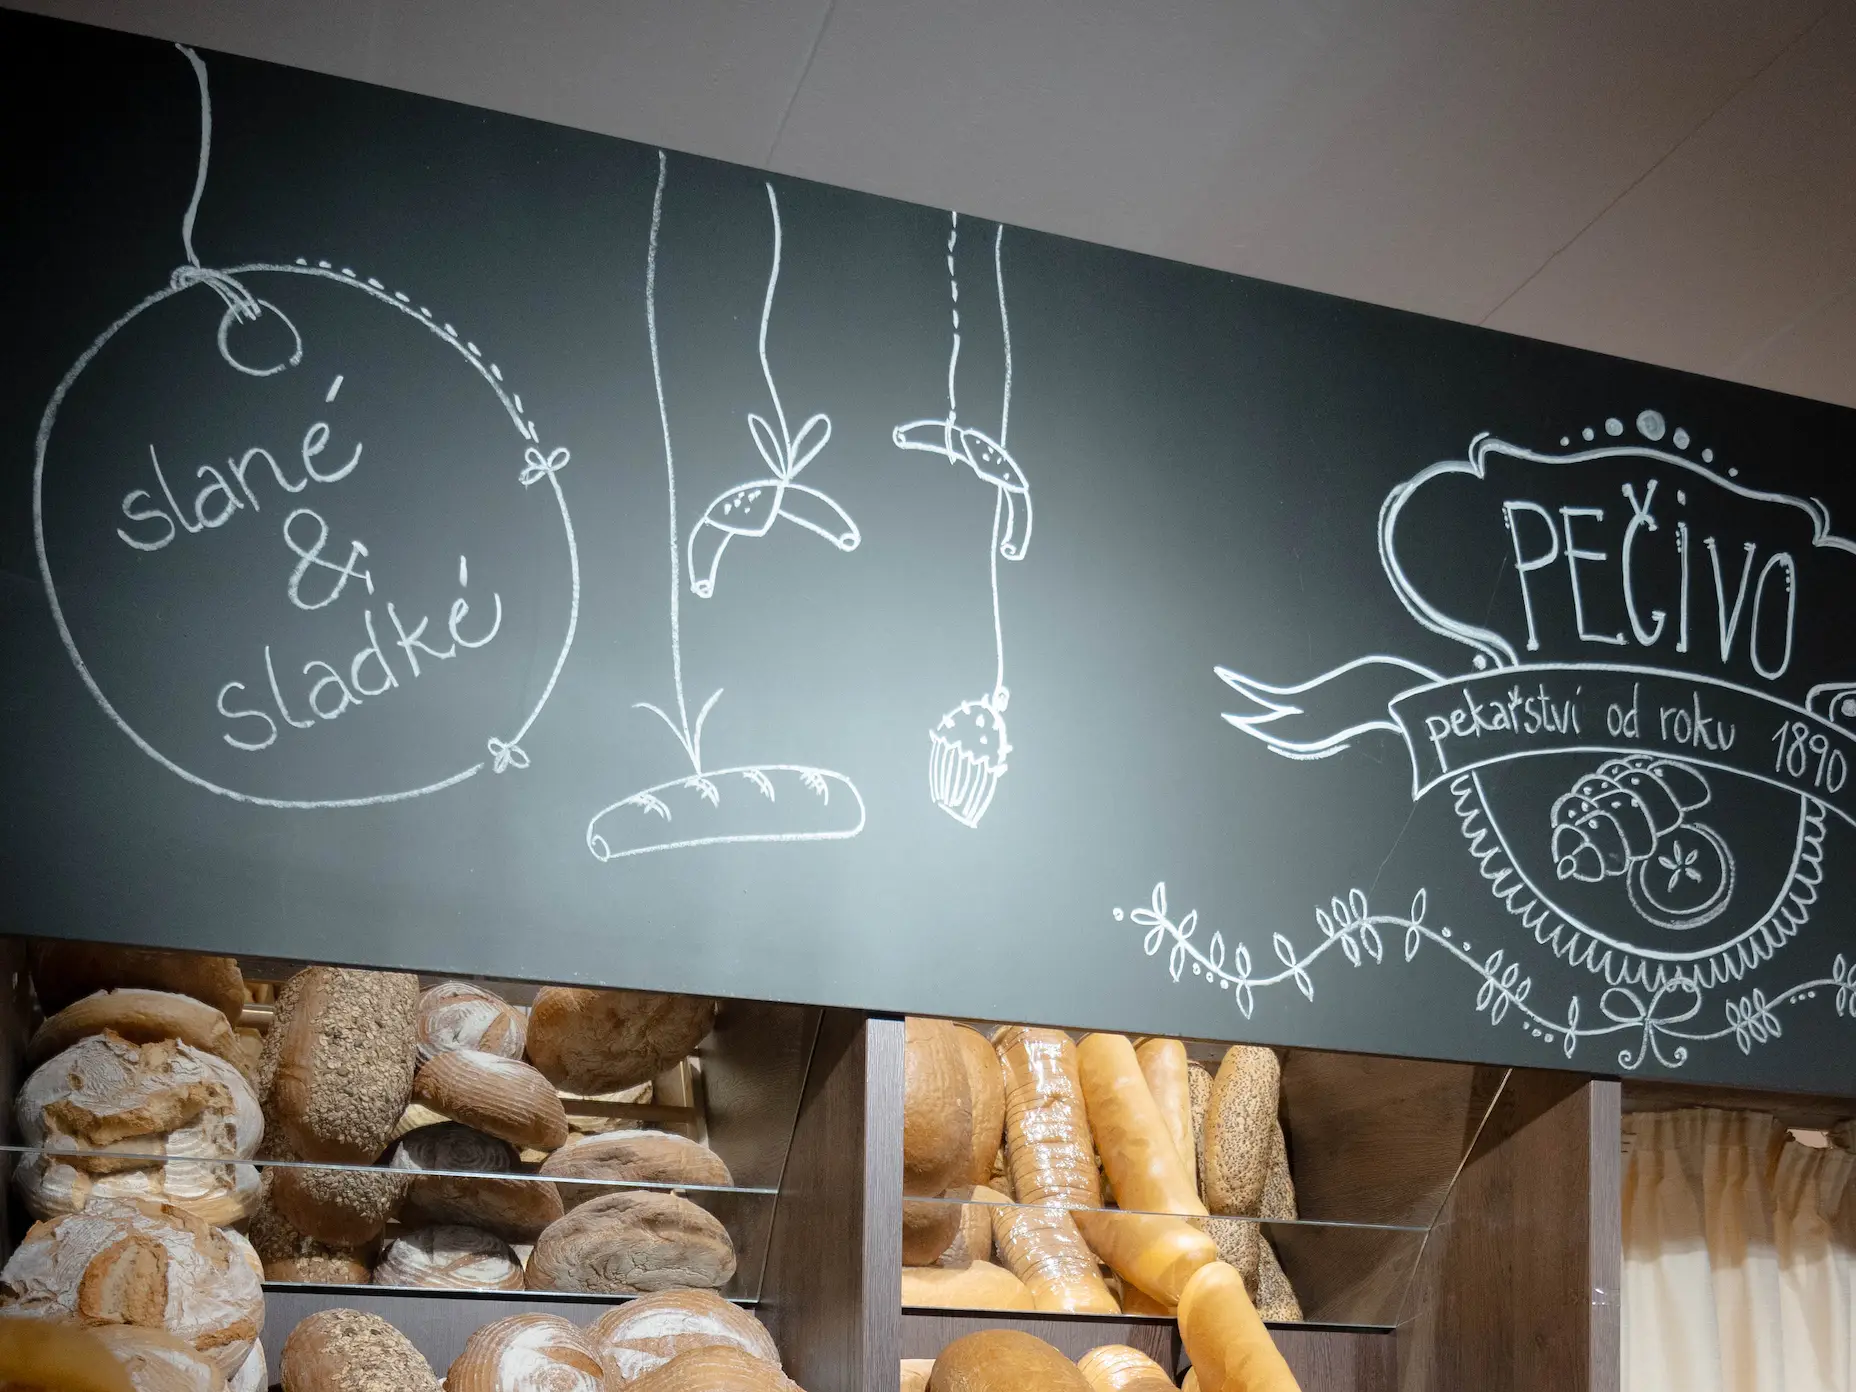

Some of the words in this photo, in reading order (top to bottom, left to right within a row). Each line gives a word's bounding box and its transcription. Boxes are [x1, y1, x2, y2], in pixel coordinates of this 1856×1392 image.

[117, 374, 363, 551] slané
[283, 508, 374, 610] &
[217, 555, 501, 751] sladké
[1425, 683, 1582, 773] pekařství
[1607, 682, 1640, 739] od
[1660, 691, 1735, 750] roku
[1771, 720, 1847, 793] 1890
